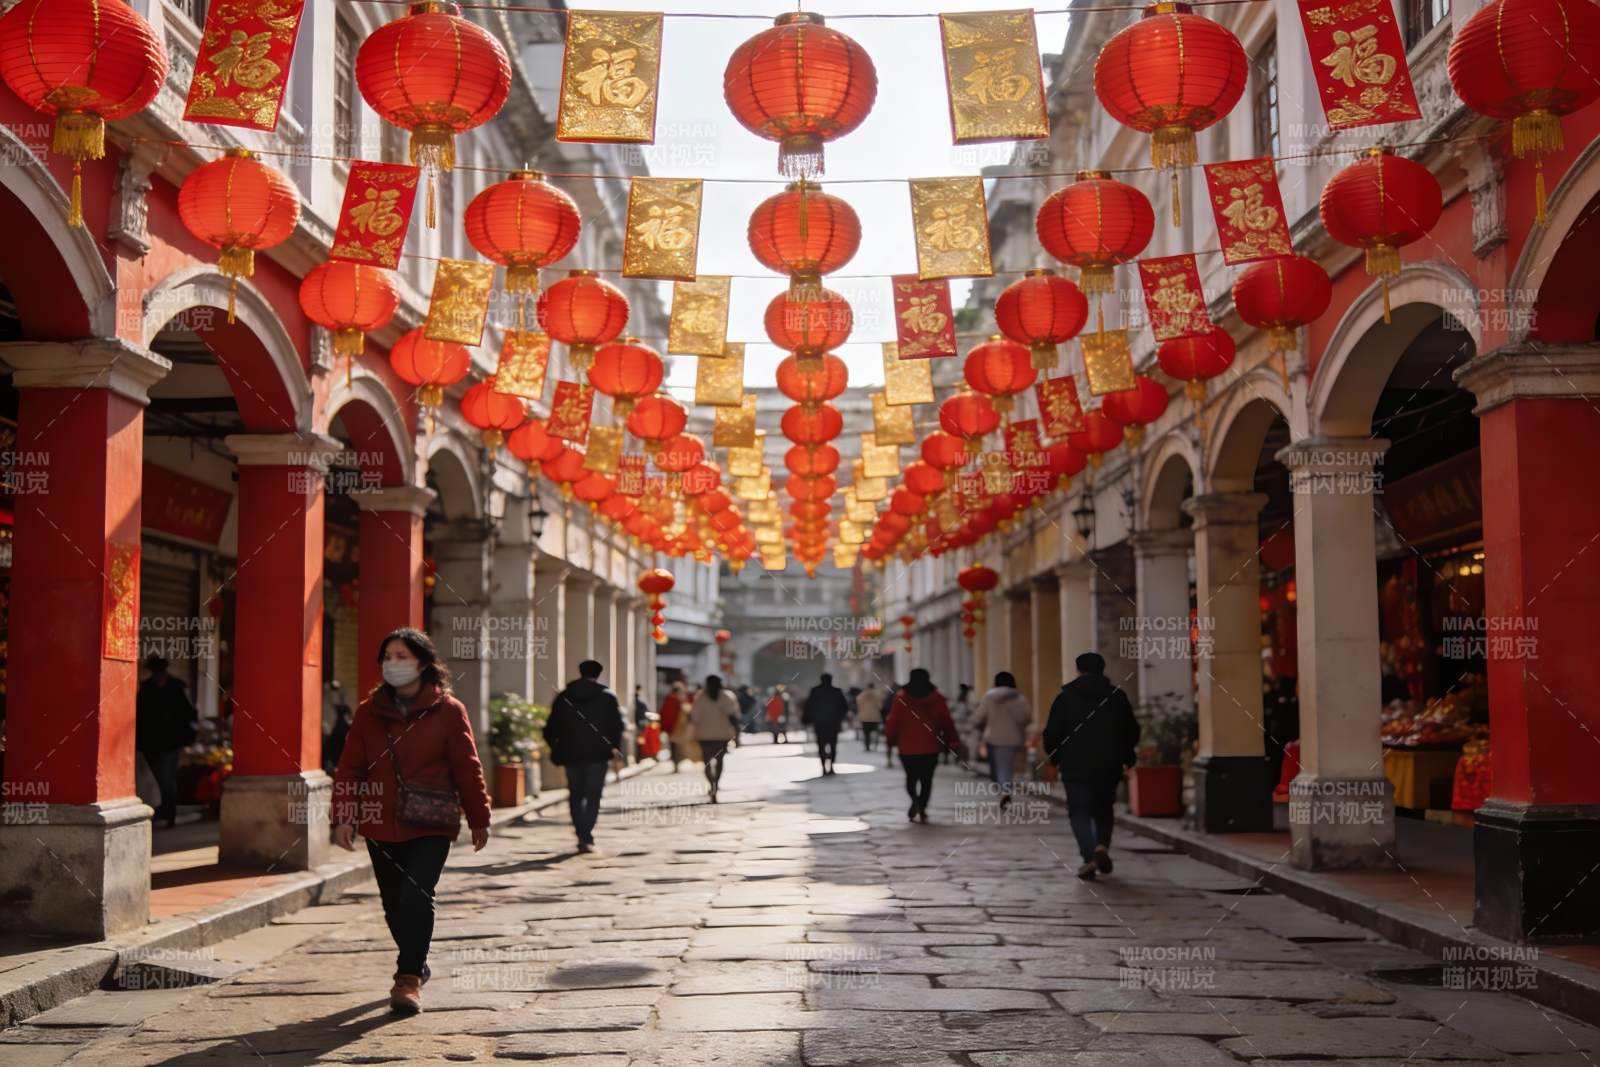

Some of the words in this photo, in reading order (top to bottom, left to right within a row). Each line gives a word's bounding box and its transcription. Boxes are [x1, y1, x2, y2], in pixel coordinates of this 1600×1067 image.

[209, 31, 281, 90] 福
[576, 48, 650, 108] 福
[962, 48, 1031, 105] 福
[1319, 25, 1397, 88] 福
[350, 187, 403, 236] 福
[635, 205, 693, 252] 福
[924, 203, 979, 253] 福
[1220, 183, 1279, 229] 福
[900, 294, 947, 334] 福
[1150, 273, 1199, 313] 福
